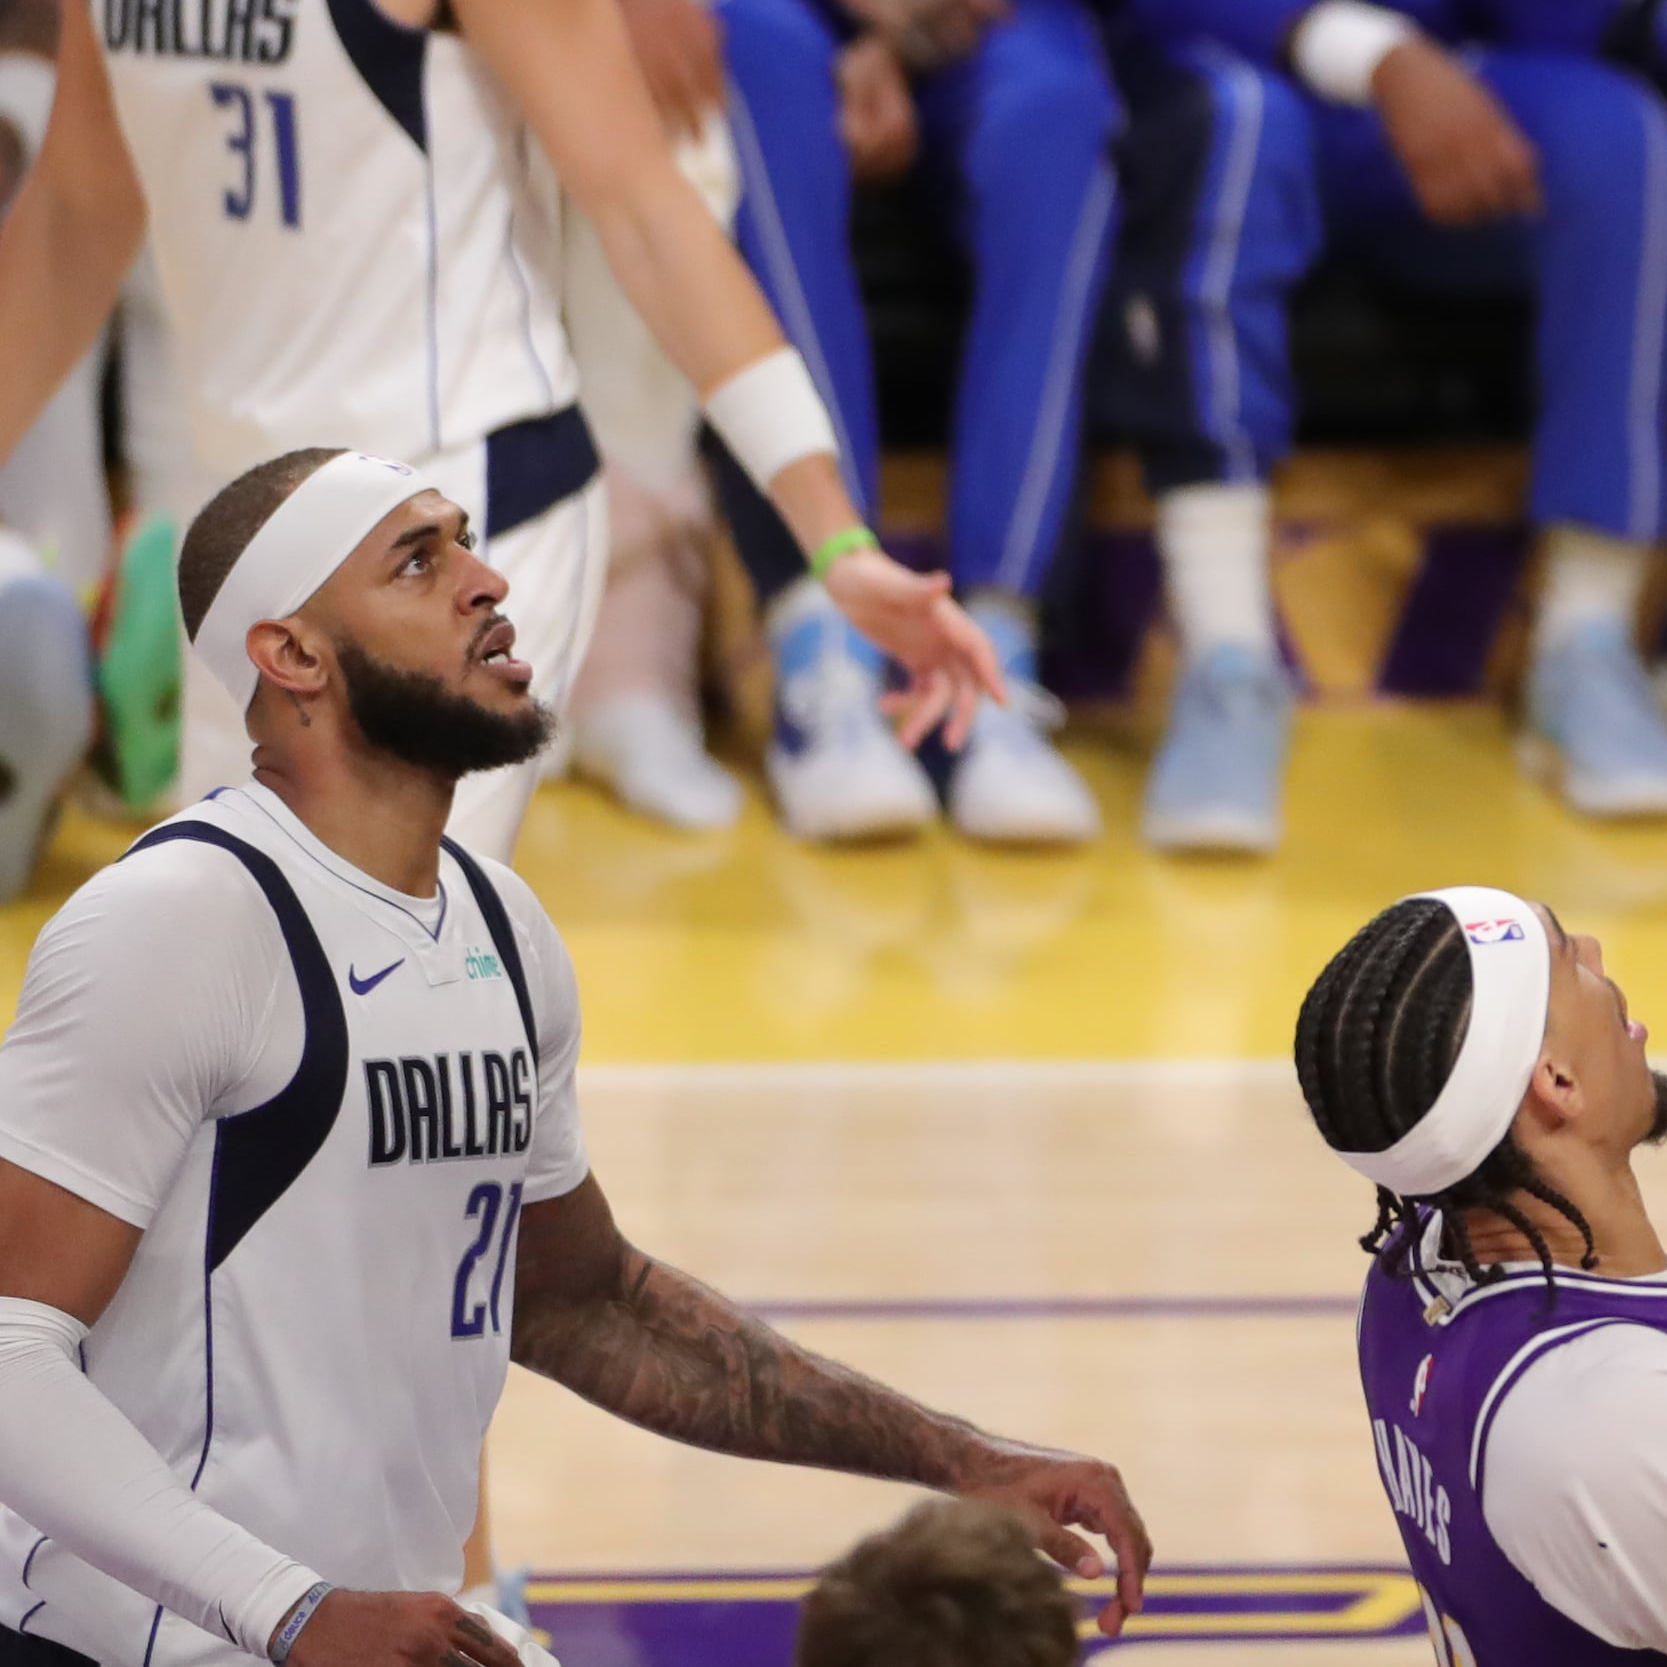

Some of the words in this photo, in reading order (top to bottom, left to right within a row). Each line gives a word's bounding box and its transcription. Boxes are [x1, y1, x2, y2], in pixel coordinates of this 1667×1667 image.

[209, 81, 301, 229] 31
[362, 1044, 534, 1169] DALLAS
[450, 1179, 525, 1343] 21
